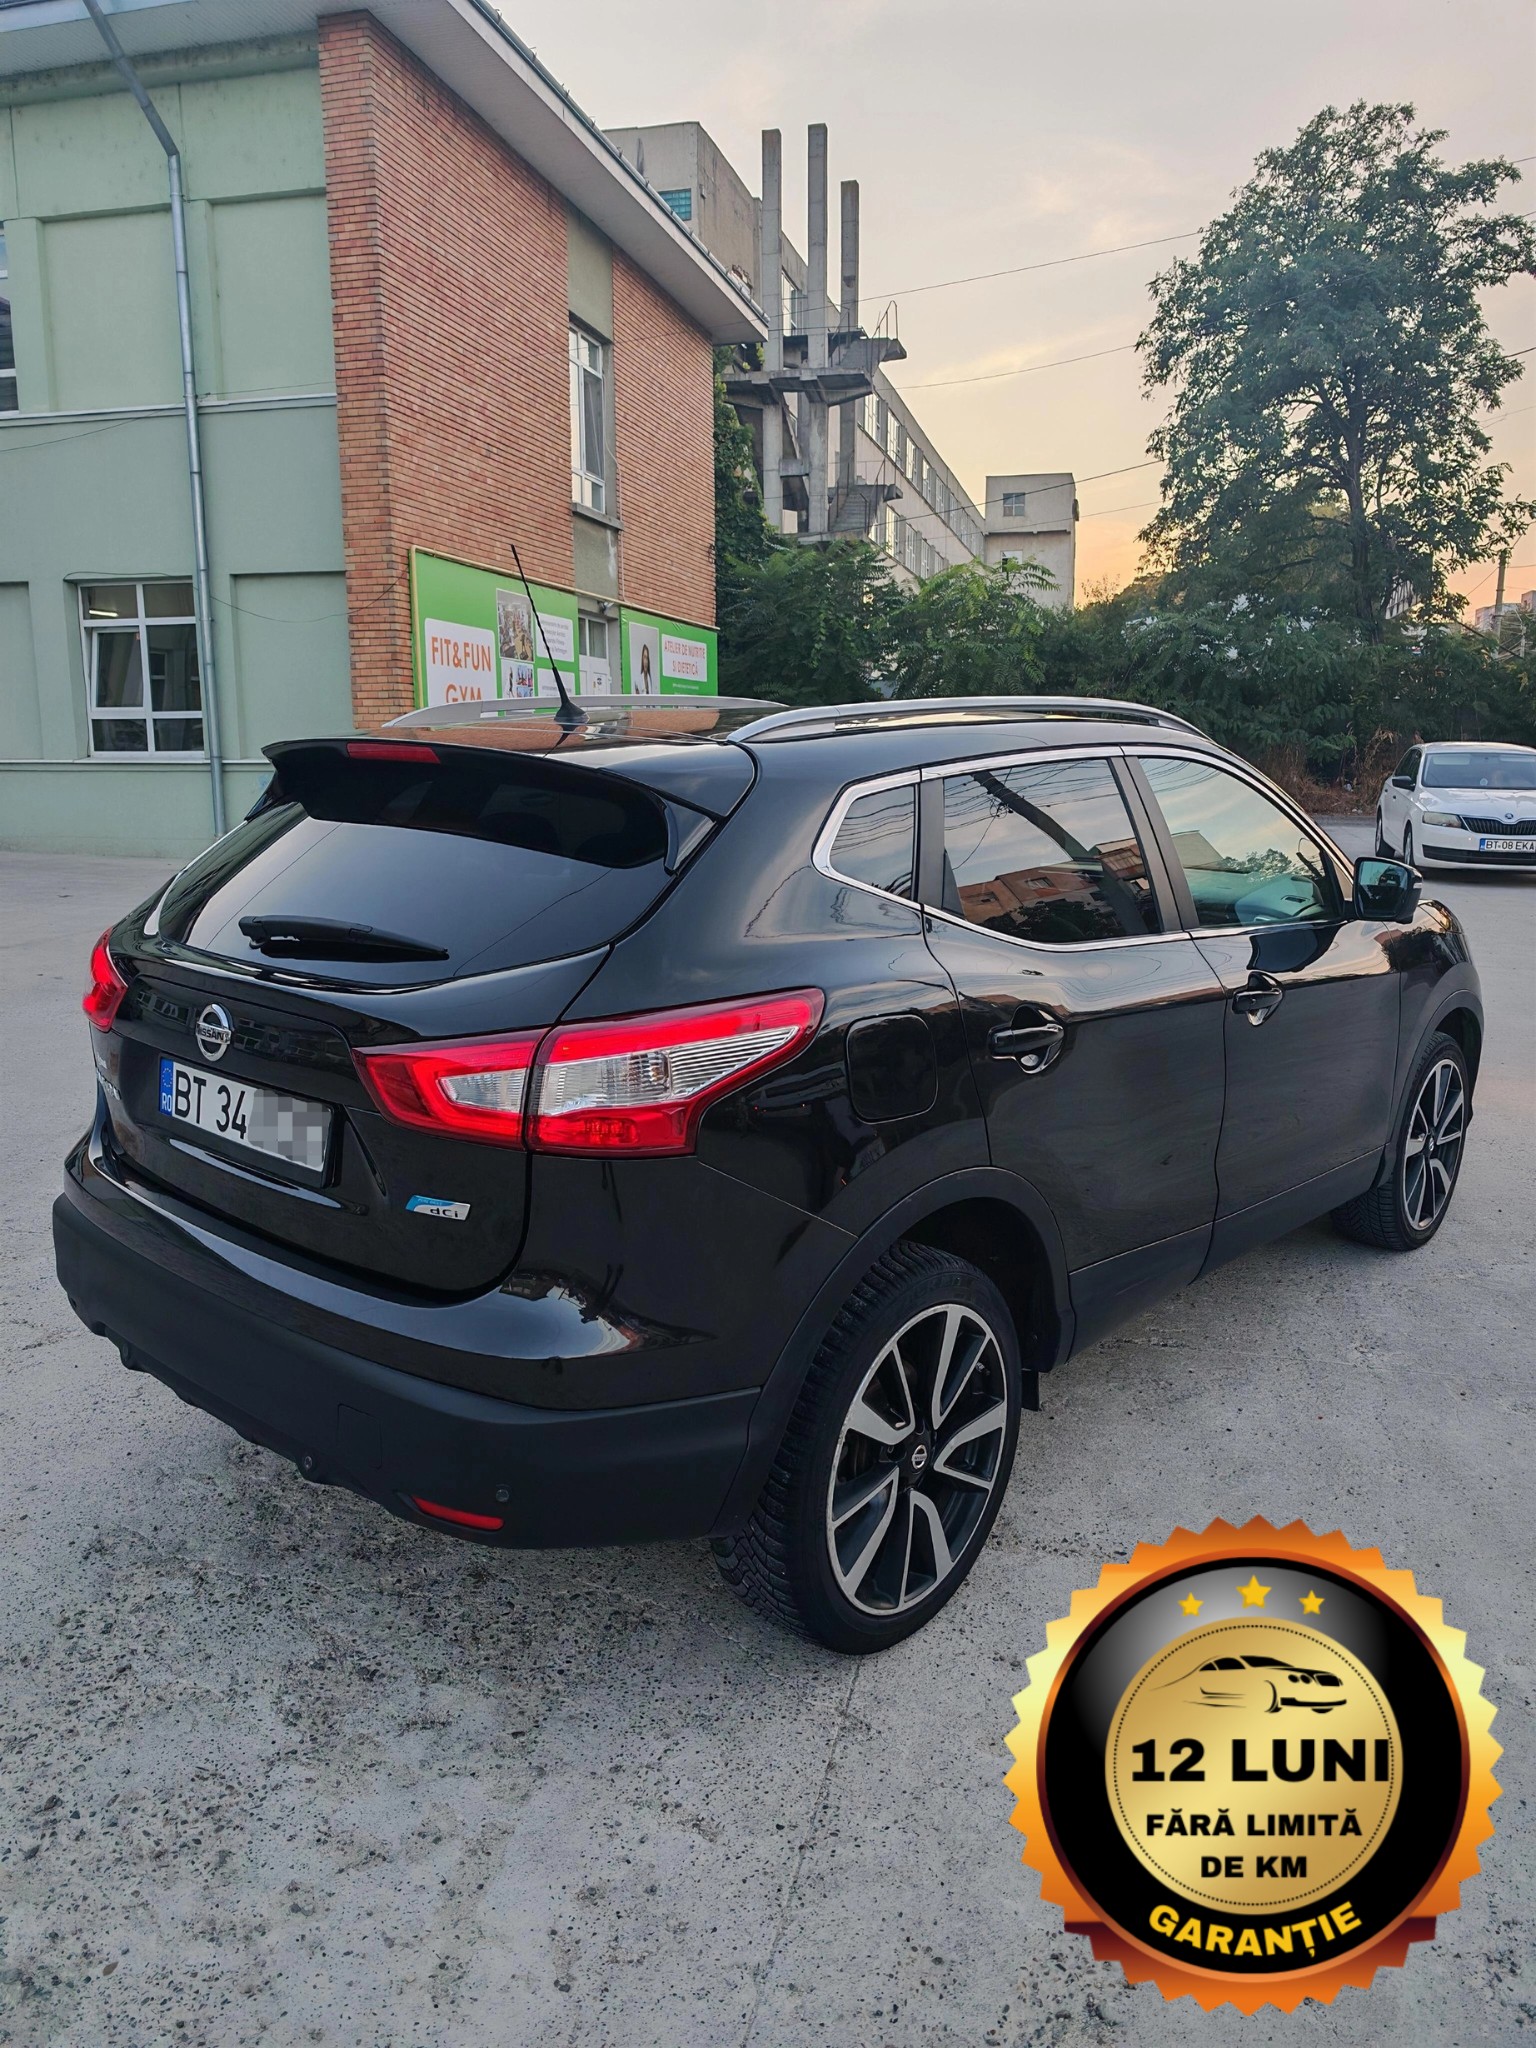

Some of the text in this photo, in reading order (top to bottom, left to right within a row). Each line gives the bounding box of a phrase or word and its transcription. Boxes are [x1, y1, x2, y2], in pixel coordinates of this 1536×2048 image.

[431, 636, 492, 673] FIT&FUN
[1501, 840, 1514, 850] 08
[1515, 841, 1535, 850] EKA
[196, 1023, 225, 1041] NISSAN
[161, 1093, 172, 1112] RO
[174, 1069, 207, 1124] BT
[216, 1084, 247, 1140] 34
[430, 1207, 459, 1218] dCi
